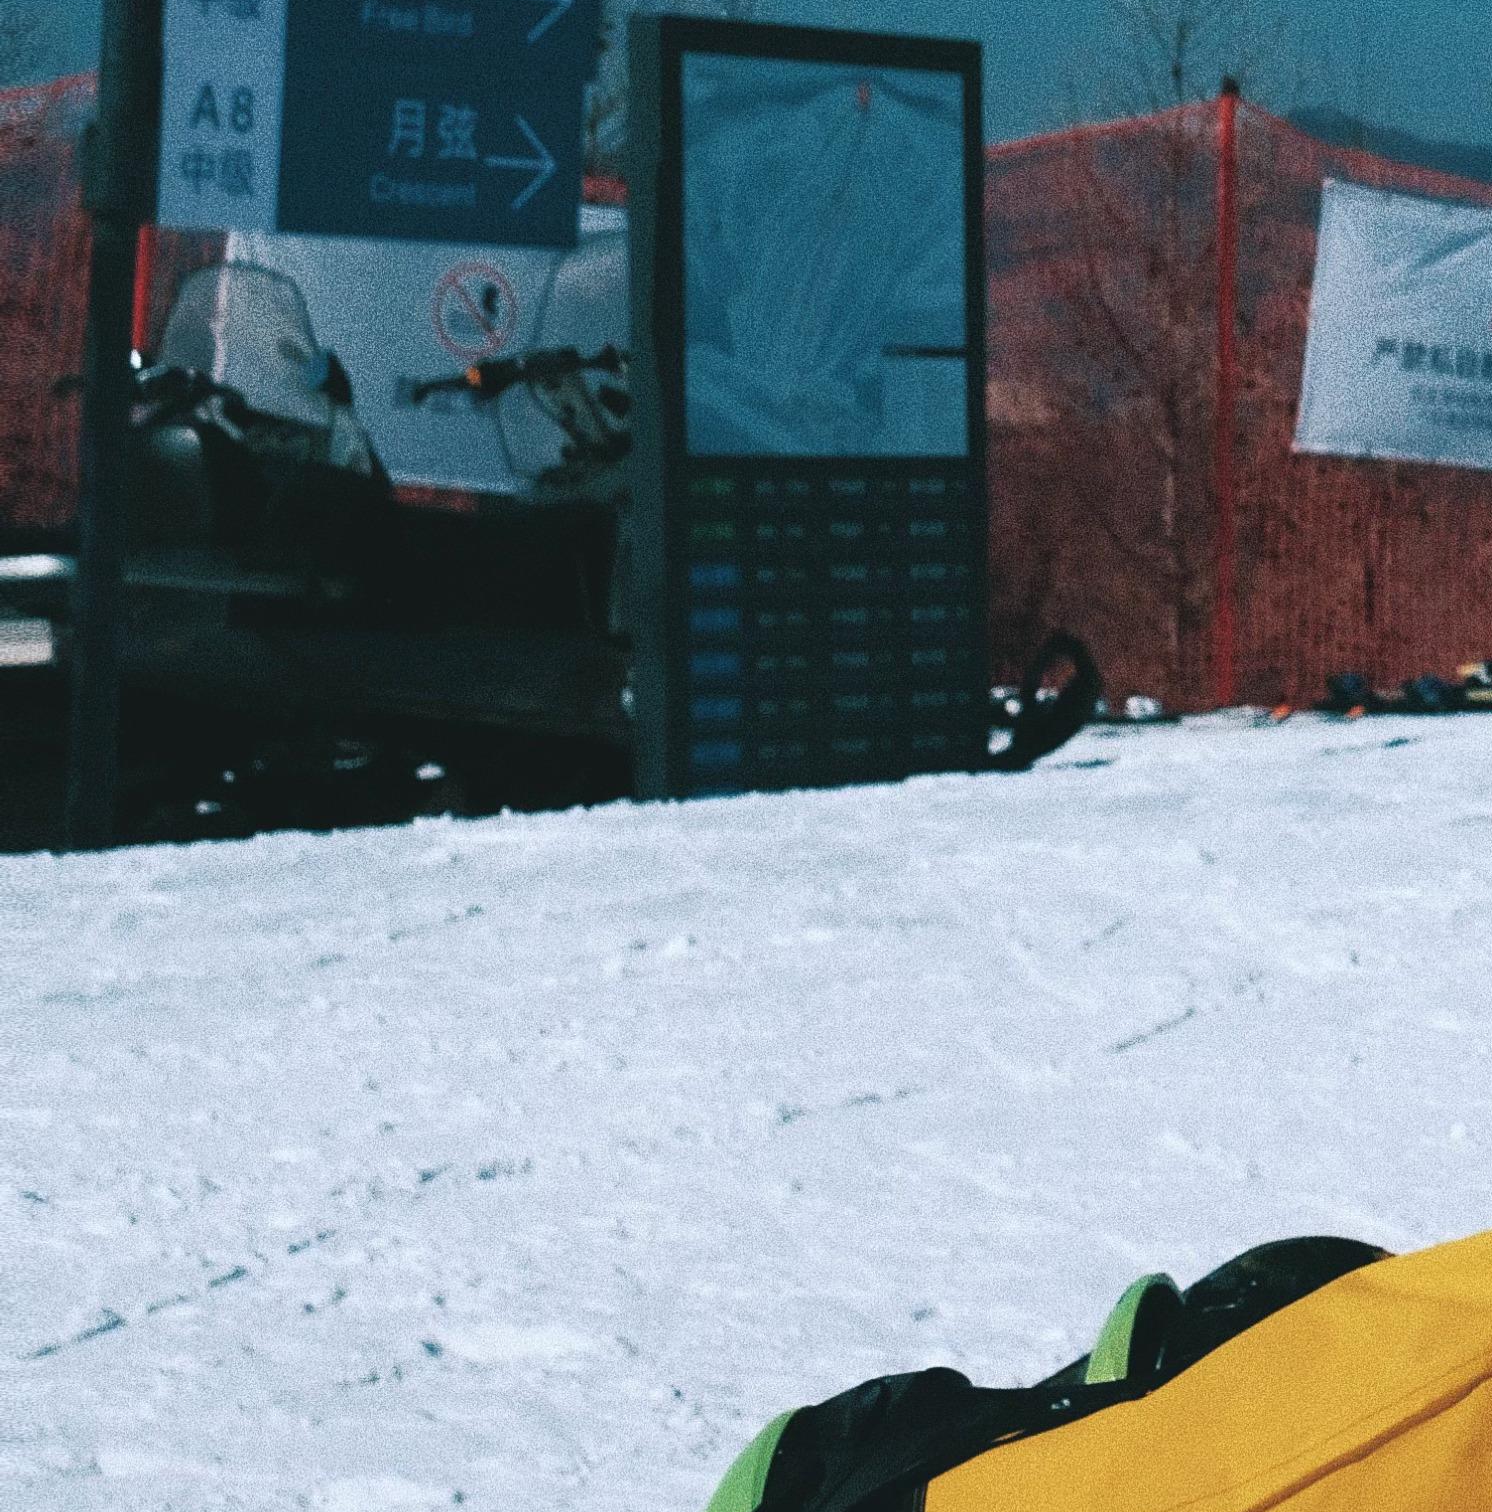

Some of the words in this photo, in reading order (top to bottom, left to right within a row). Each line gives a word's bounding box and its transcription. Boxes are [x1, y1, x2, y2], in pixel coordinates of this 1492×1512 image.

[192, 85, 255, 133] A8
[390, 100, 479, 158] 月弦
[182, 147, 256, 196] 中级
